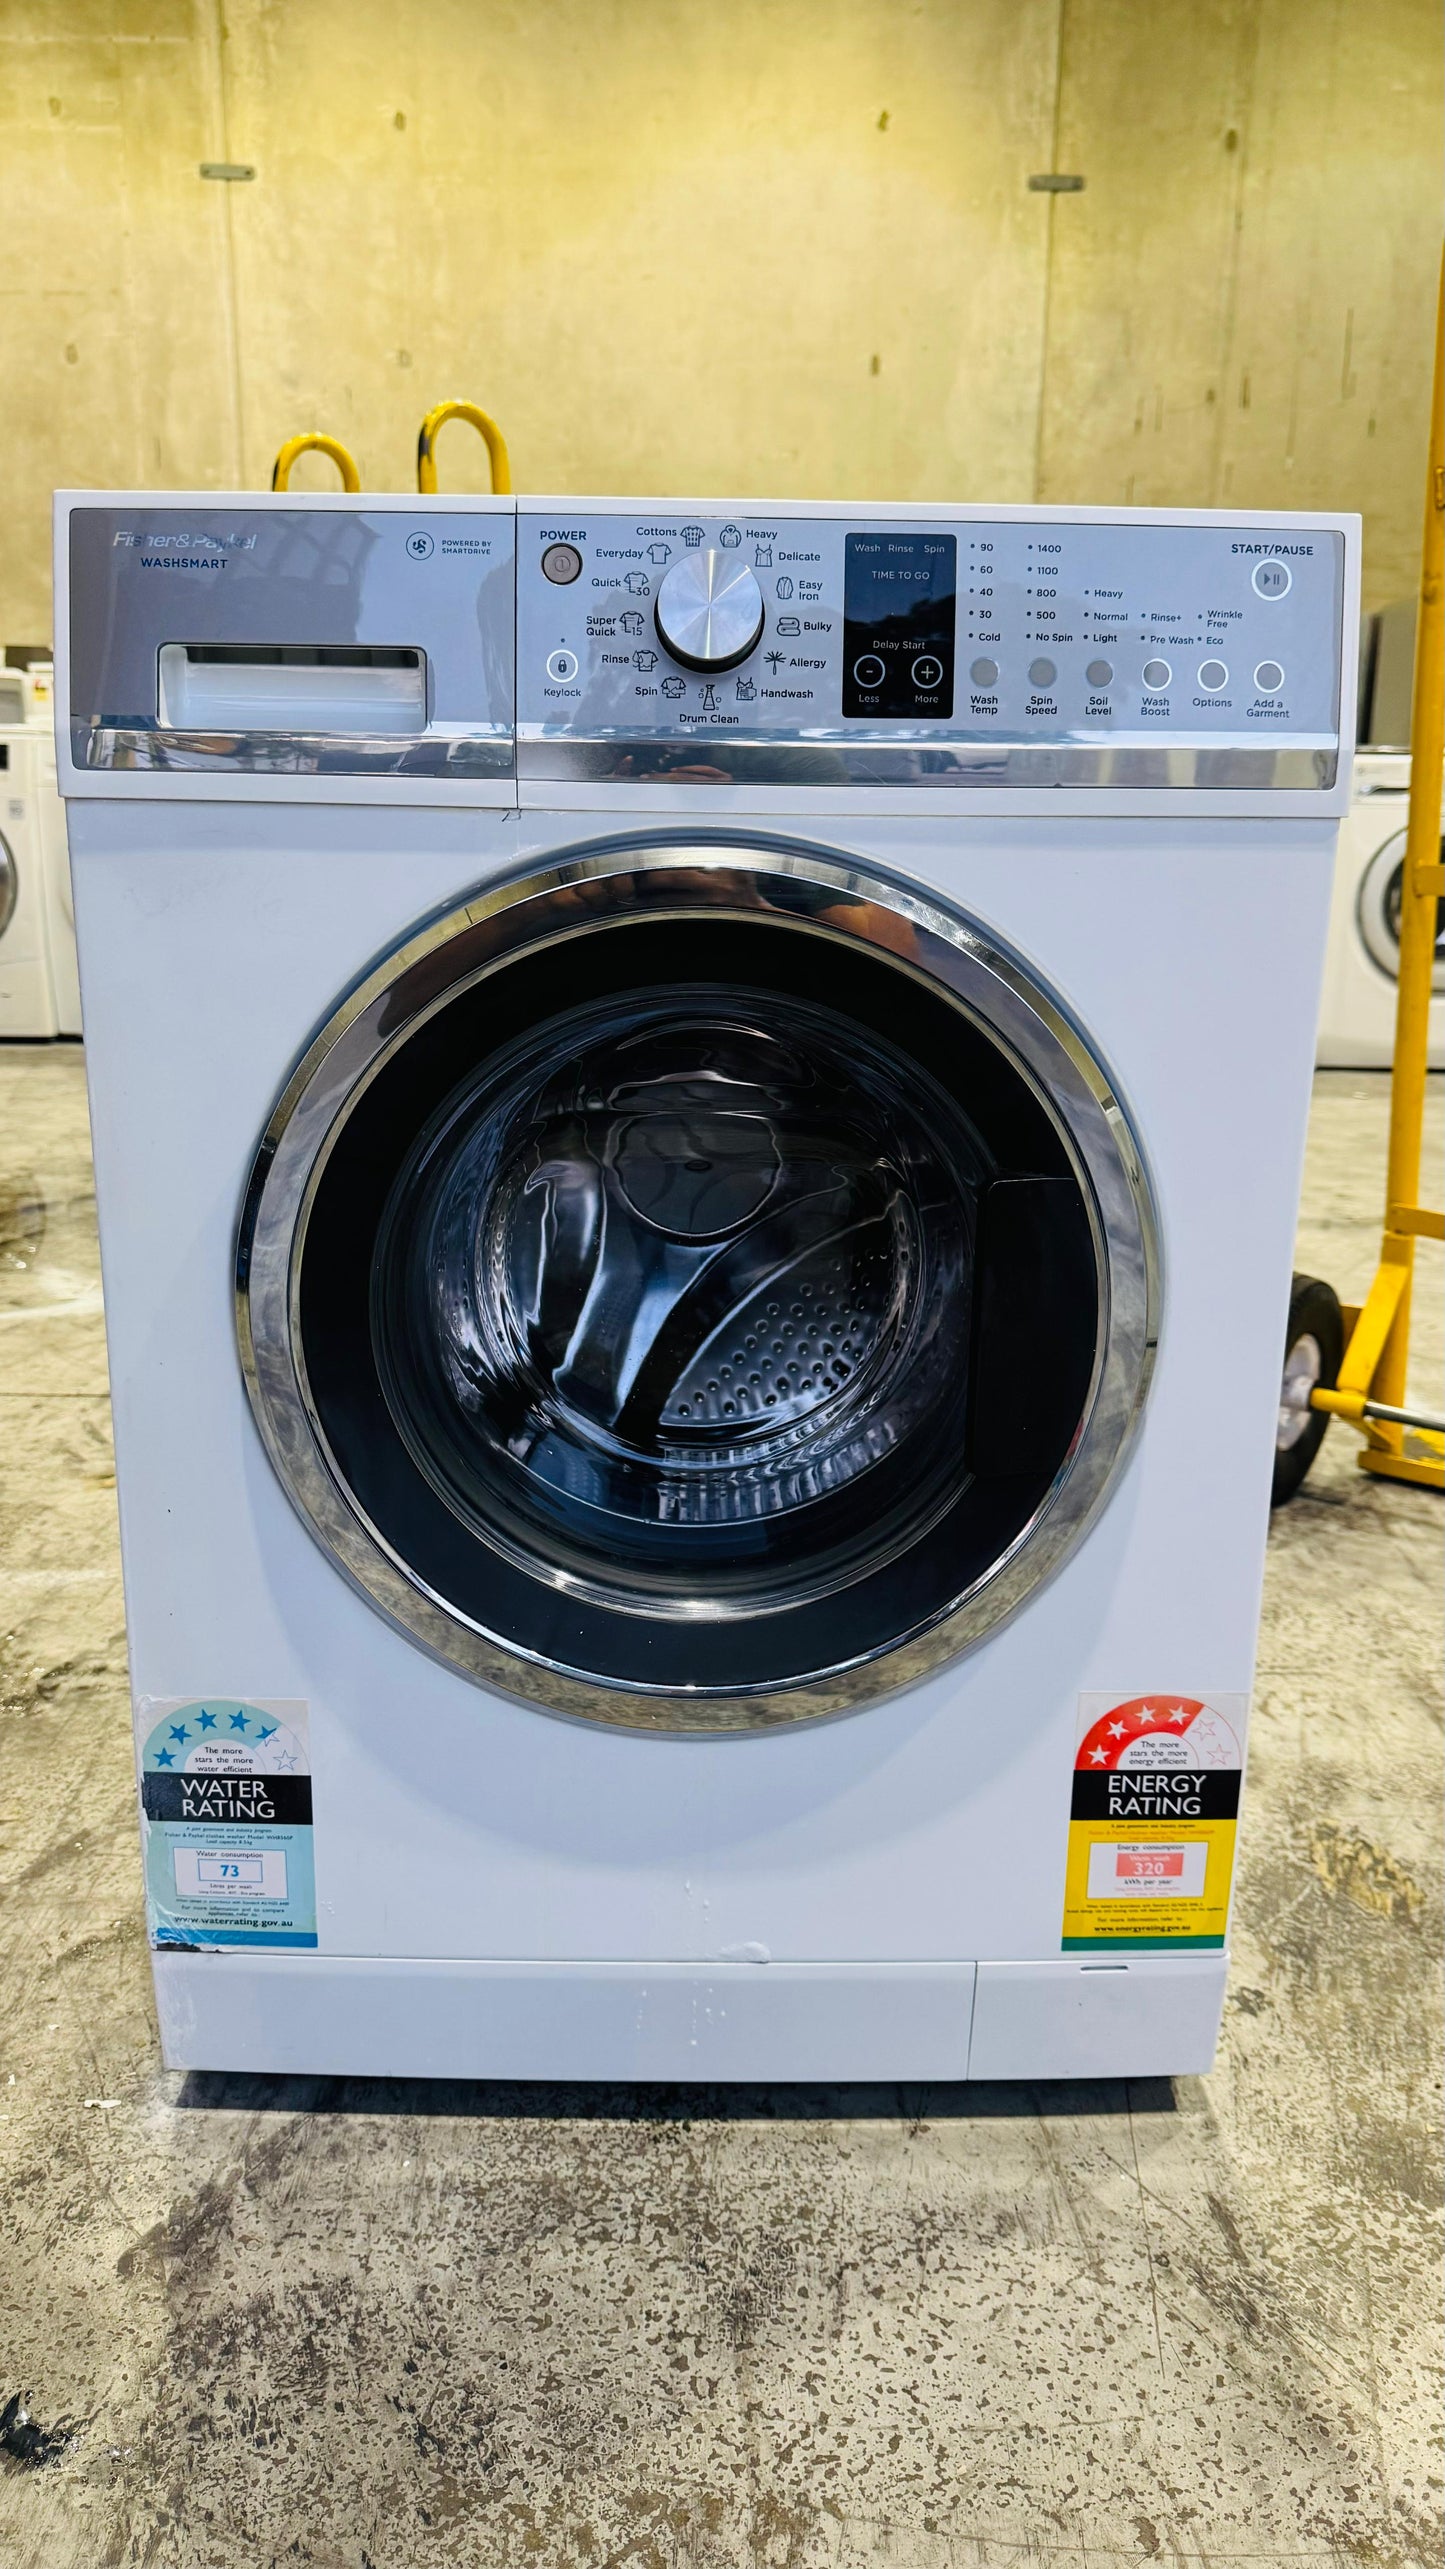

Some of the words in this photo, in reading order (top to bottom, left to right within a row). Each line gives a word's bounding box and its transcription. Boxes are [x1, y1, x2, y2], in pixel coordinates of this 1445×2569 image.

[540, 530, 587, 541] POWER
[636, 527, 677, 537] Cottons
[746, 529, 778, 540] Heavy
[855, 544, 881, 553] Wash
[888, 544, 914, 553] Rinse
[924, 545, 945, 554] Spin
[980, 544, 993, 552] 90
[1038, 544, 1062, 553] 1400
[1231, 544, 1314, 556] START/PAUSE
[596, 548, 644, 560] Everyday
[778, 552, 821, 562] Delicate
[141, 557, 228, 569] WASHSMART
[980, 566, 993, 574] 60
[1038, 567, 1058, 575] 1100
[872, 571, 895, 580] TIME
[899, 571, 912, 580] TO
[914, 571, 930, 580] GO
[591, 578, 621, 589] Quick
[799, 581, 822, 591] Easy
[636, 587, 650, 596] 30
[799, 592, 819, 601] Iron
[980, 588, 993, 596] 40
[1036, 589, 1057, 598] 800
[1094, 589, 1123, 599] Heavy
[979, 610, 992, 619] 30
[1036, 611, 1056, 620] 500
[1094, 612, 1128, 621] Normal
[1151, 613, 1182, 622] Rinse+
[1207, 610, 1243, 620] Wrinkle
[586, 616, 616, 627] Super
[804, 621, 832, 632] Bulky
[1207, 620, 1228, 628] Free
[586, 627, 616, 638] Quick
[632, 627, 643, 636] 15
[979, 633, 1001, 642] Cold
[1036, 633, 1050, 641] No
[1052, 633, 1073, 643] Spin
[1093, 634, 1117, 643] Light
[1150, 636, 1166, 645] Pre
[1169, 636, 1194, 645] Wash
[1206, 637, 1223, 645] Eco
[873, 640, 900, 651] Delay
[902, 641, 925, 650] Start
[602, 655, 630, 664] Rinse
[789, 658, 827, 669] Allergy
[544, 688, 581, 699] Keylock
[635, 686, 658, 698] Spin
[761, 689, 814, 699] Handwash
[858, 695, 880, 703] Less
[915, 695, 939, 704] More
[971, 696, 998, 705] Wash
[1030, 696, 1053, 706] Spin
[1089, 696, 1108, 706] Soil
[1142, 698, 1170, 707] Wash
[1193, 698, 1232, 708] Options
[1254, 700, 1275, 709] Add
[971, 706, 998, 715] Temp
[1025, 706, 1057, 716] Speed
[1085, 706, 1112, 716] Level
[1141, 707, 1170, 716] Boost
[1247, 709, 1290, 718] Garment
[679, 714, 707, 724] Drum
[710, 714, 739, 724] Clean
[180, 1778, 268, 1799] WATER
[1108, 1775, 1207, 1794] ENERGY
[182, 1801, 276, 1819] RATING
[1109, 1797, 1202, 1816] RATING
[221, 1851, 264, 1859] consumption
[220, 1864, 240, 1878] 73
[1135, 1863, 1165, 1875] 320
